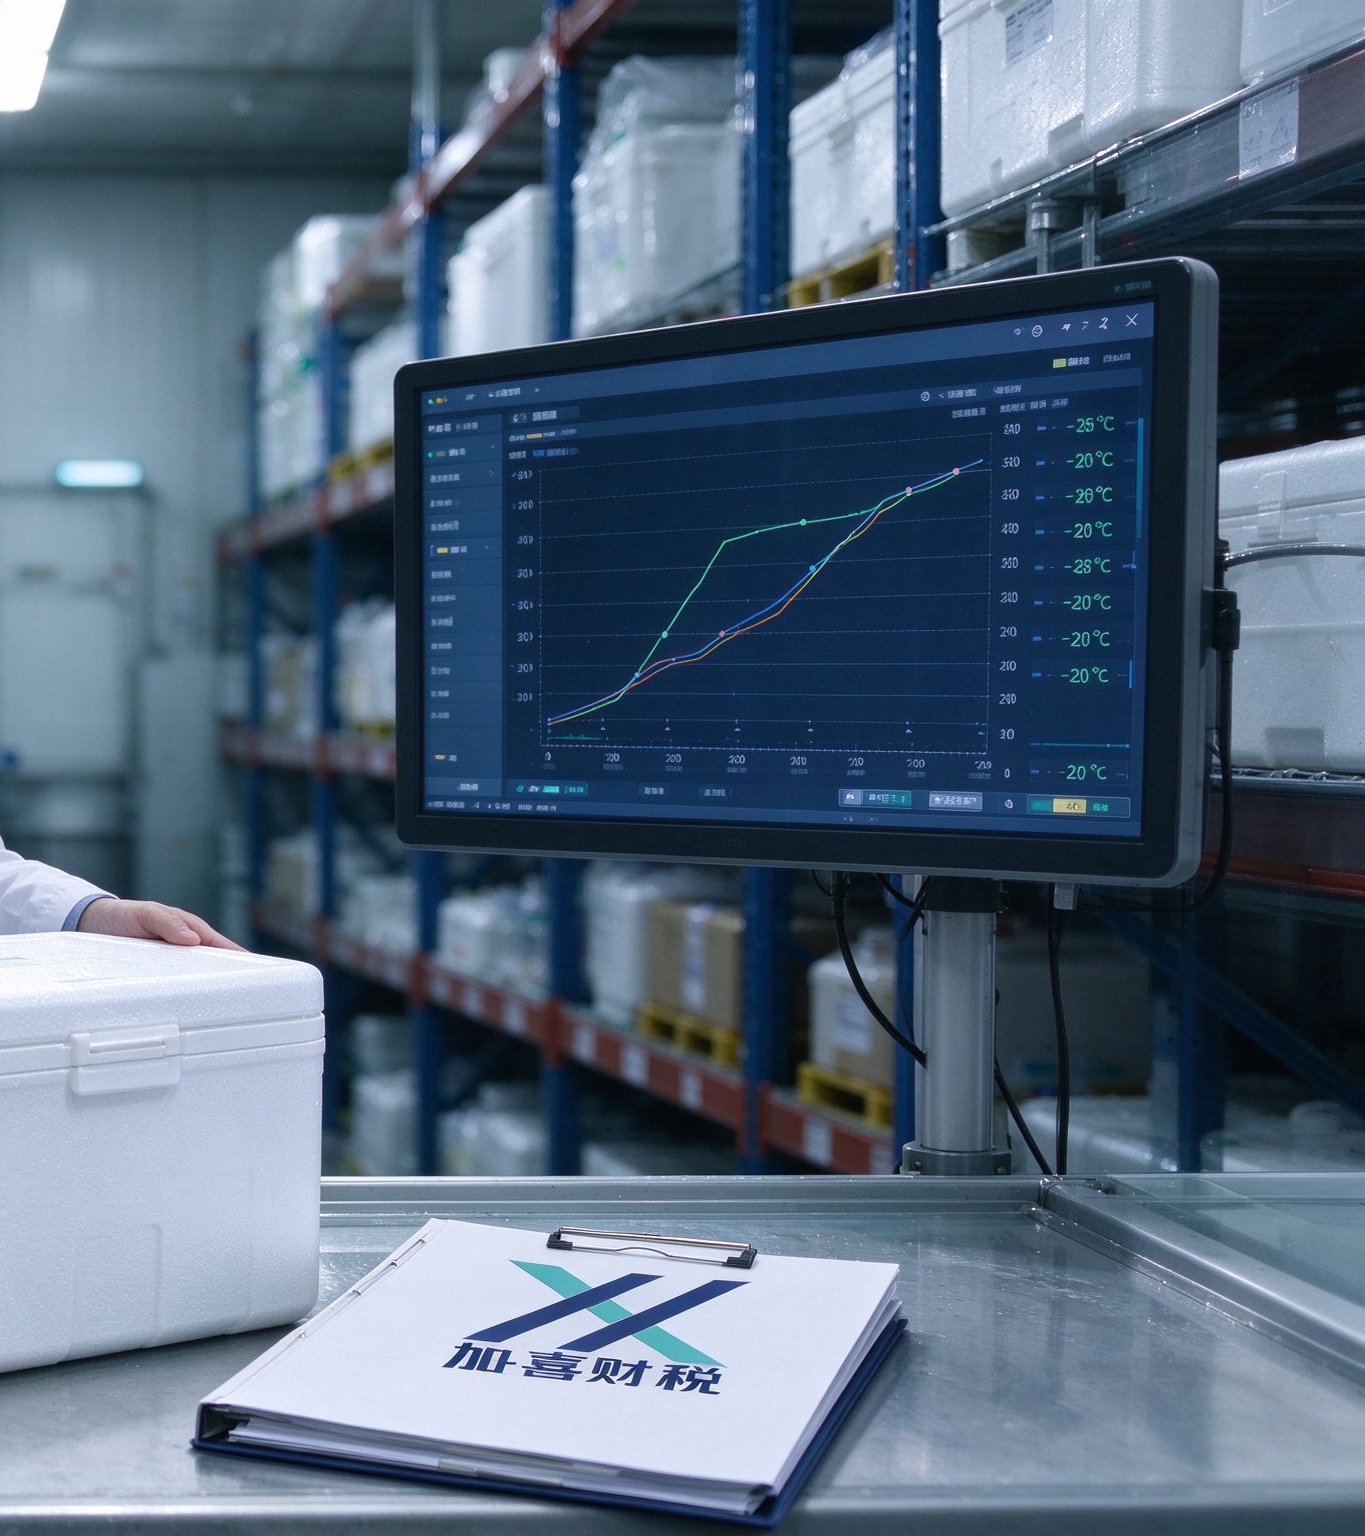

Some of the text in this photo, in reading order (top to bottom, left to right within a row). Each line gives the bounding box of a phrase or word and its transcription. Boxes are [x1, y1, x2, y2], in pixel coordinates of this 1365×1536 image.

[1066, 451, 1114, 468] -20°C
[1064, 521, 1112, 538] -20°C
[1063, 593, 1111, 610] -20°C
[1062, 630, 1110, 647] -20°C
[1061, 667, 1109, 683] -20°C
[1004, 768, 1011, 778] 0
[1059, 764, 1107, 780] -20°C
[442, 1342, 722, 1396] 加喜财税
